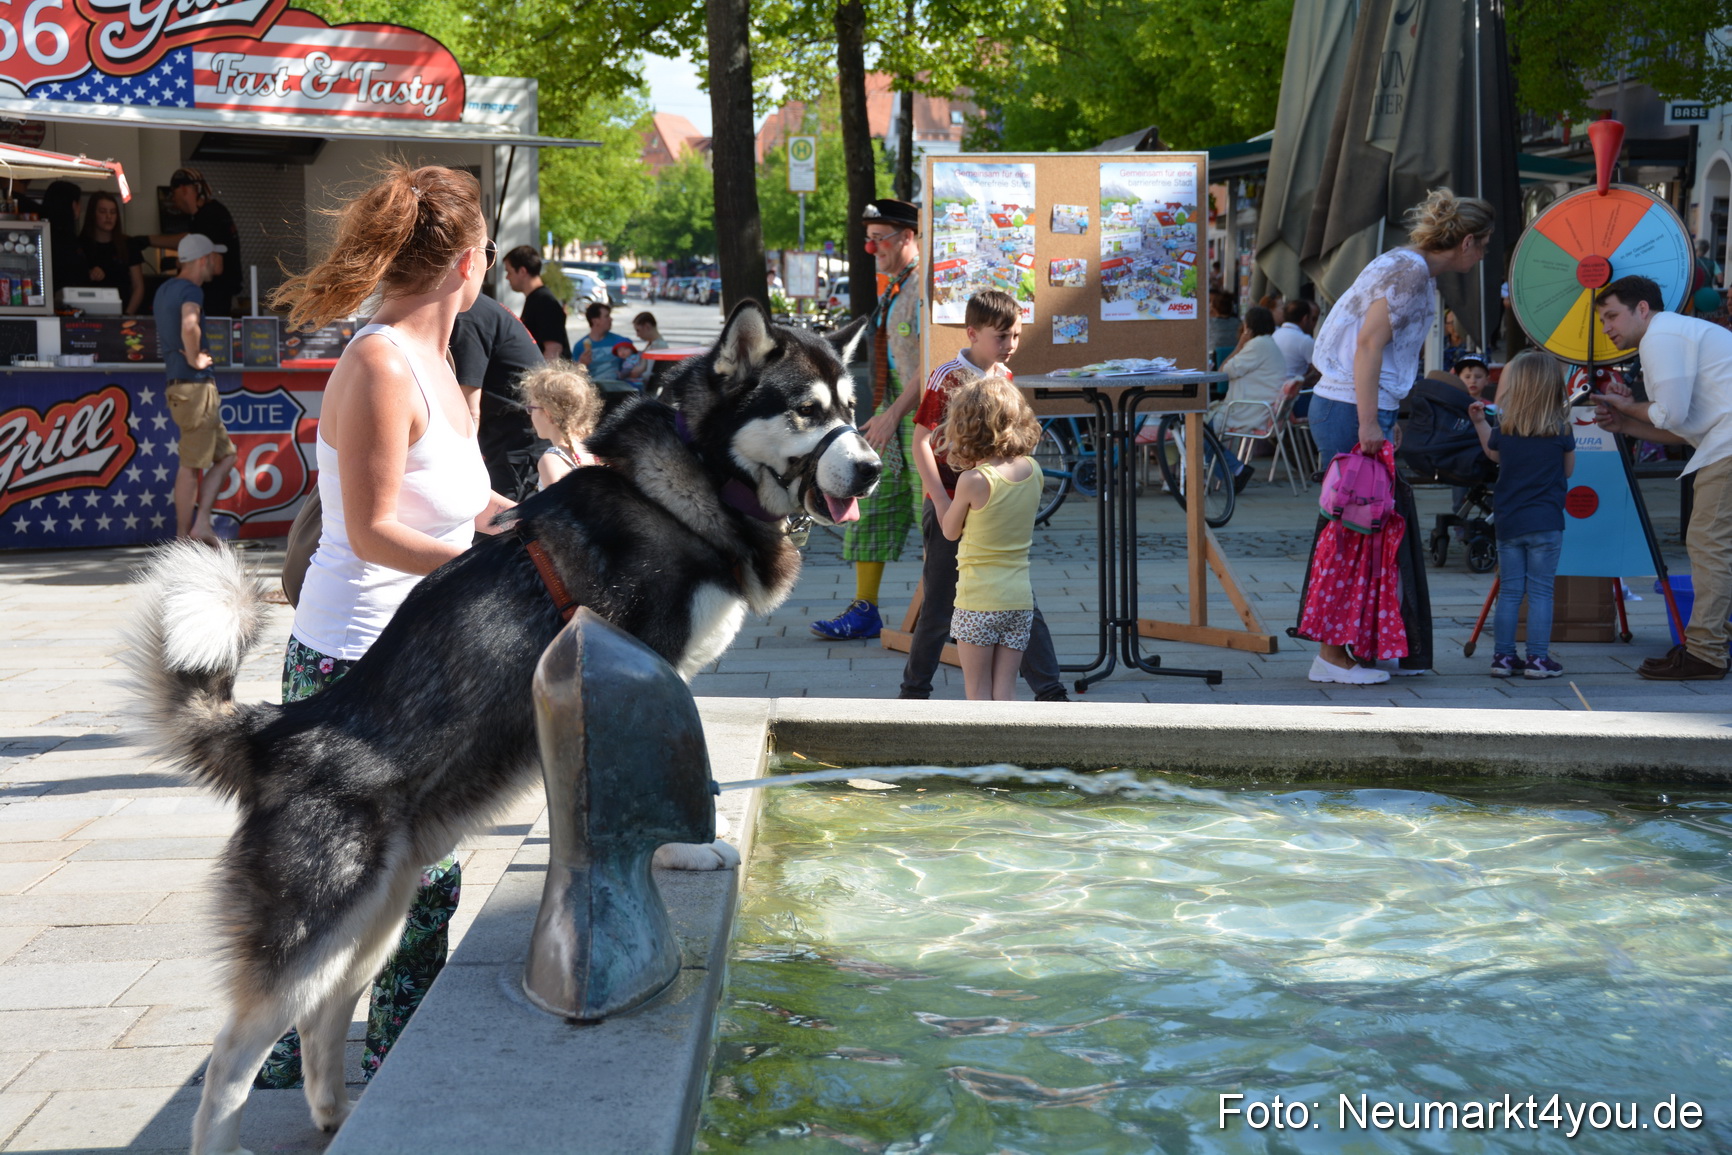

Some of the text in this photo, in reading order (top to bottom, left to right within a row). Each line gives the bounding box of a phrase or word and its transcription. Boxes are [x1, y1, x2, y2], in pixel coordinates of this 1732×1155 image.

[211, 50, 448, 116] Fast & Tasty
[1674, 108, 1707, 117] BASE
[954, 169, 999, 177] Gemeinsam
[1002, 169, 1012, 178] für
[1120, 169, 1192, 177] Gemeinsam für eine
[1128, 179, 1193, 187] barrierefreie Stadt
[221, 404, 284, 425] OUTE
